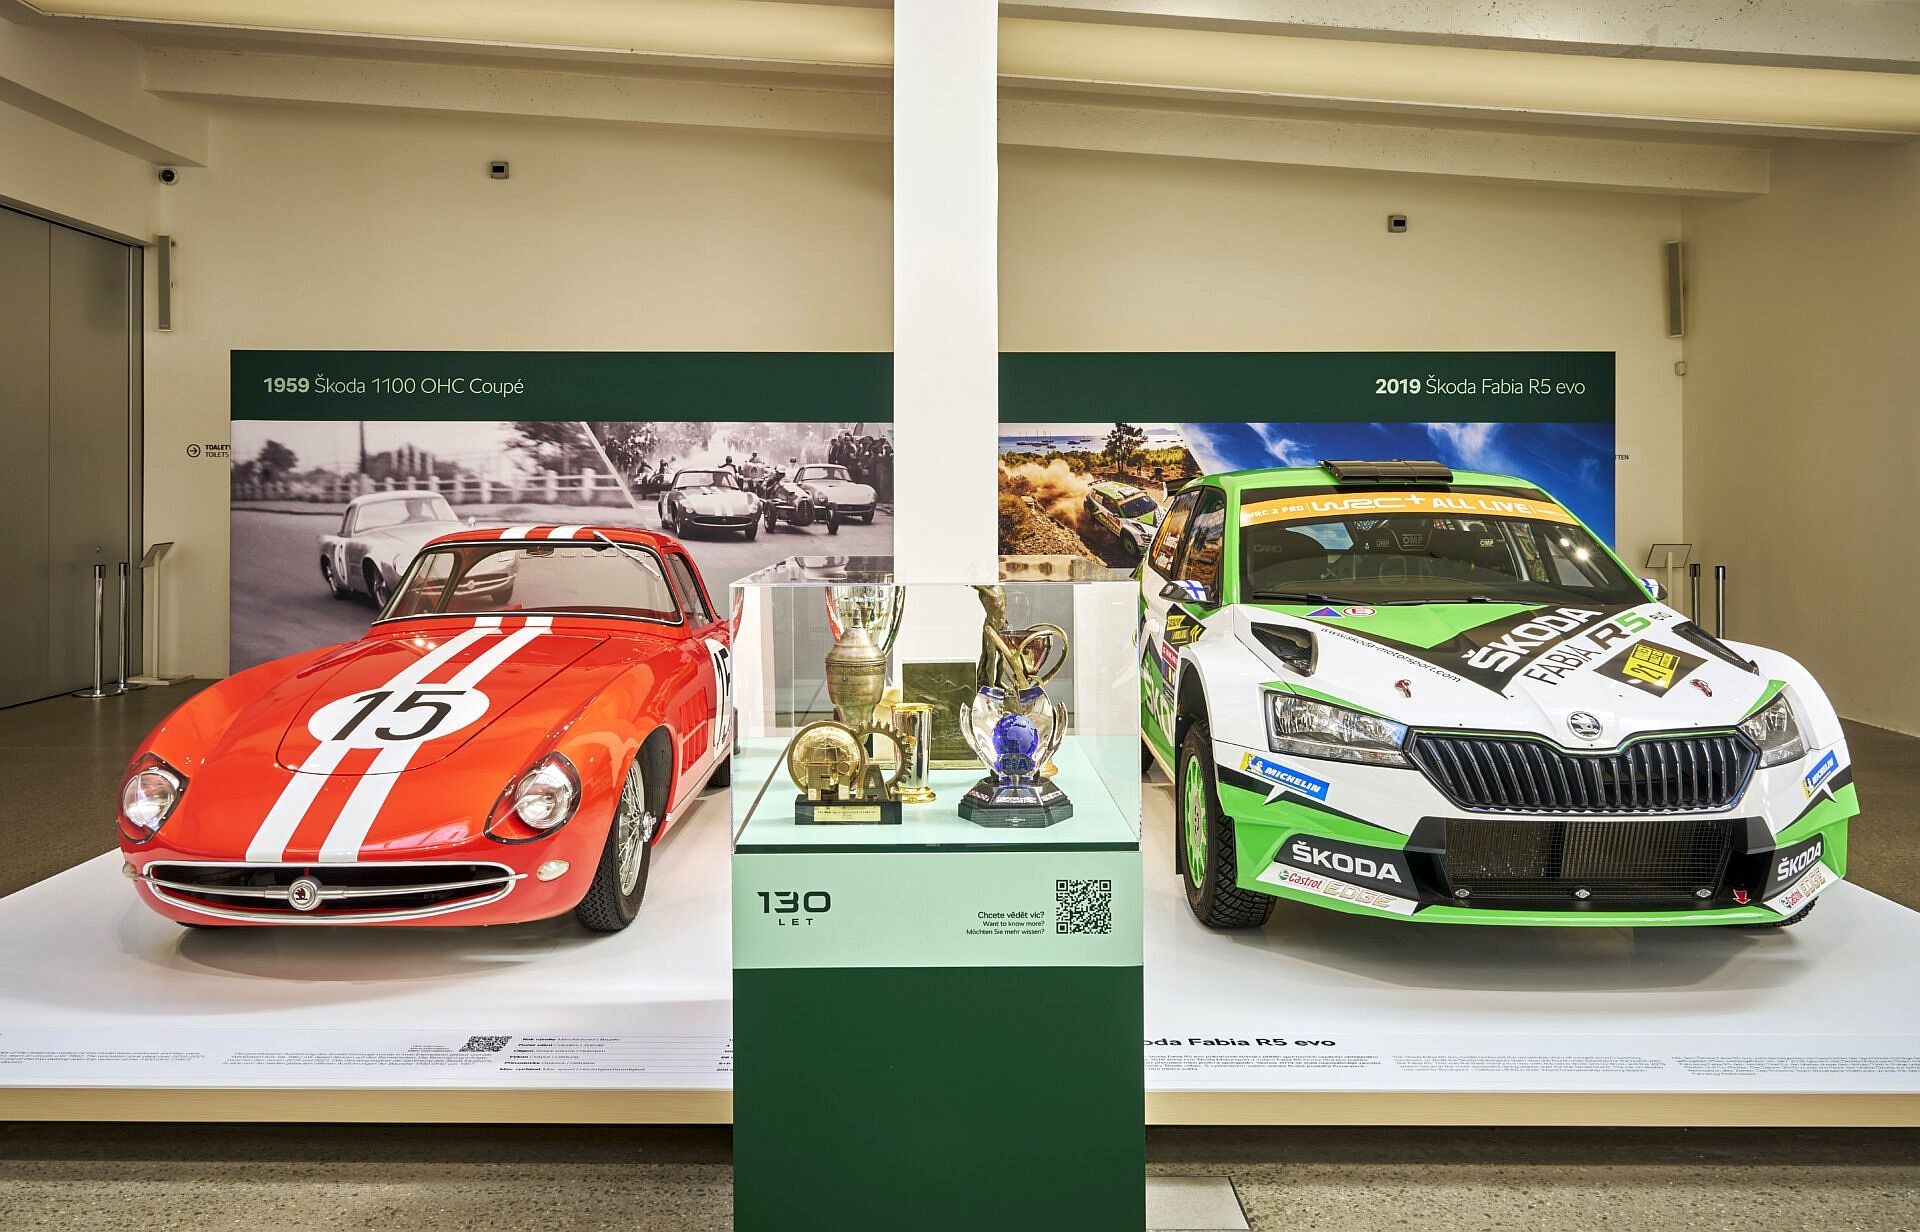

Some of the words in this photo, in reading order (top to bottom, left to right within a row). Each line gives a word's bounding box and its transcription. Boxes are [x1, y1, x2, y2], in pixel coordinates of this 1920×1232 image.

[263, 377, 310, 393] 1959
[314, 373, 366, 394] Škoda
[371, 378, 415, 393] 1100
[420, 378, 465, 394] OHC
[469, 378, 524, 397] Coupé
[1375, 378, 1421, 395] 2019
[1425, 374, 1476, 395] Škoda
[1481, 378, 1523, 395] Fabia
[1528, 378, 1552, 395] R5
[1555, 382, 1586, 395] evo
[1281, 505, 1304, 513] PRO
[1432, 498, 1476, 510] ALL
[1477, 499, 1532, 514] LIVE
[1402, 536, 1423, 544] OMP
[1480, 539, 1494, 547] OMP
[1461, 607, 1604, 672] ŠKODA
[1522, 644, 1602, 685] FABIA
[1585, 612, 1652, 650] R5
[1630, 663, 1667, 681] 21
[331, 690, 467, 741] 15
[1265, 767, 1322, 793] MICHELIN
[1292, 841, 1402, 883] ŠKODA
[1777, 841, 1822, 882] ŠKODA
[1288, 873, 1324, 890] Castrol
[1323, 880, 1398, 909] EDGE
[757, 891, 831, 913] 130
[778, 918, 814, 926] LET
[977, 911, 1005, 919] Chcete
[1144, 1038, 1182, 1046] oda
[1188, 1038, 1251, 1046] Fabia
[1255, 1038, 1288, 1046] R5
